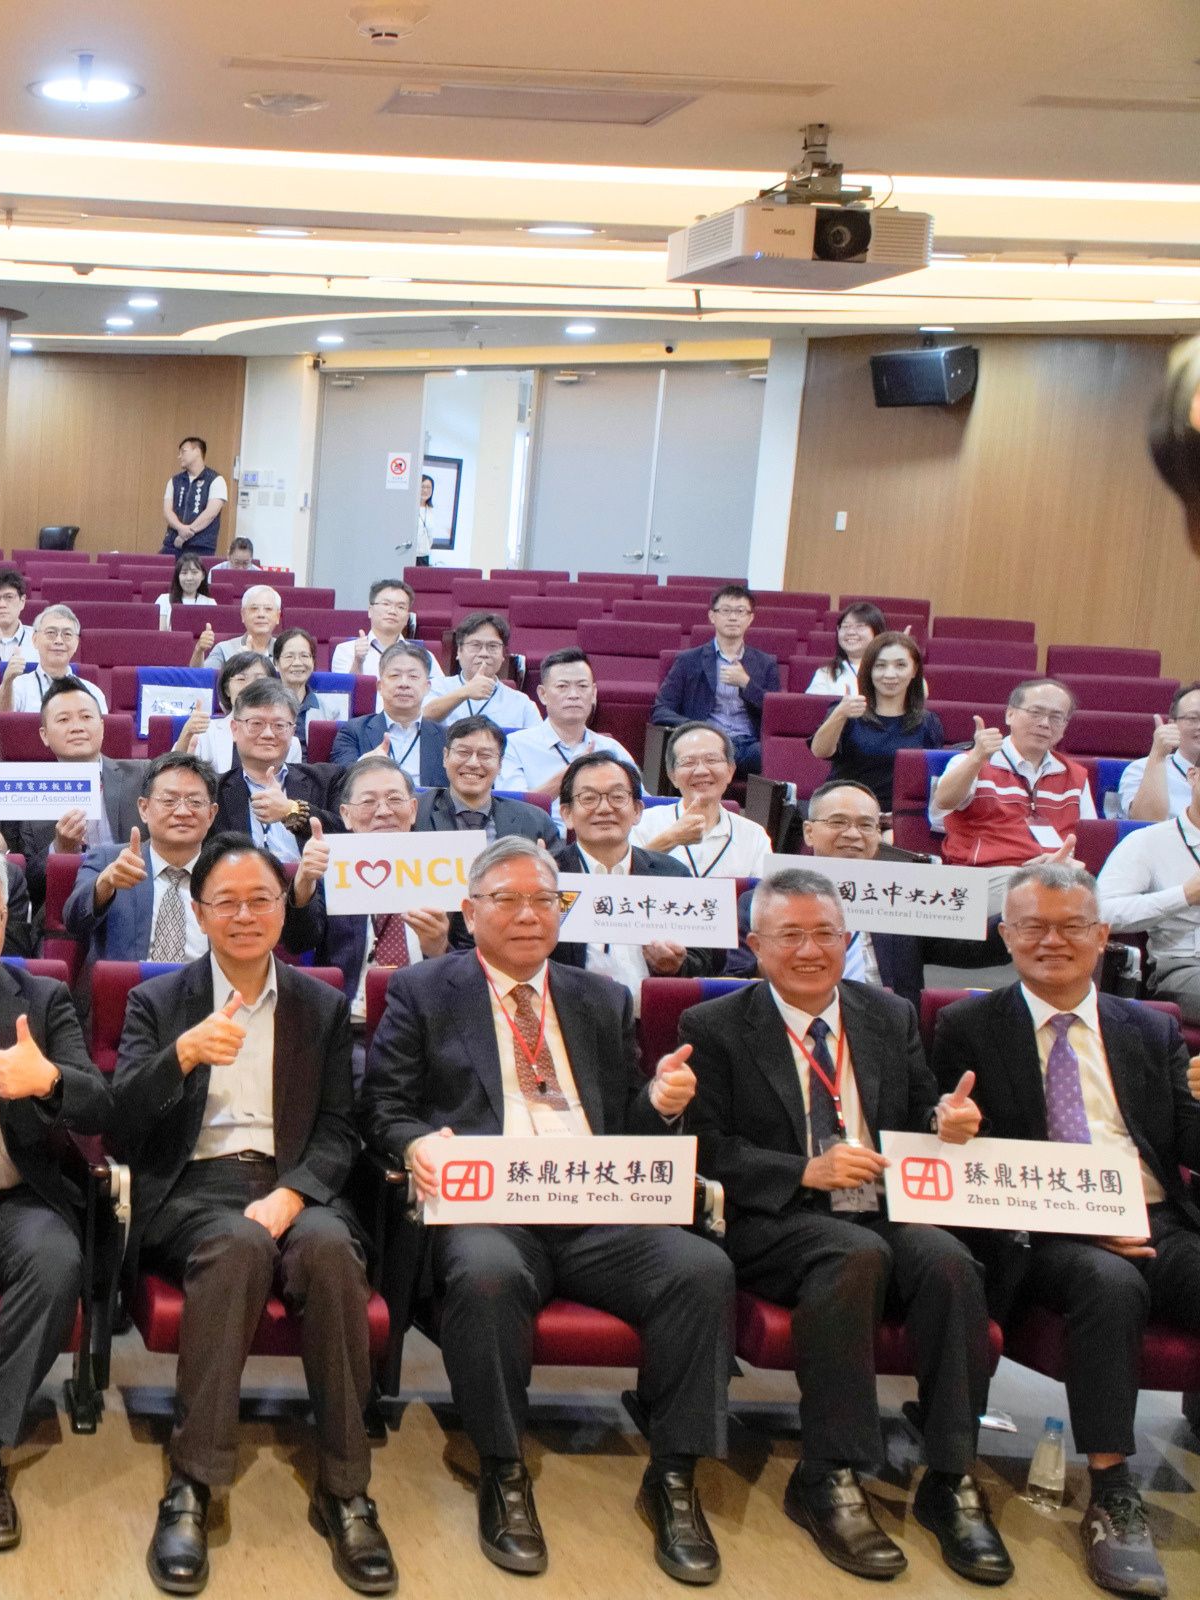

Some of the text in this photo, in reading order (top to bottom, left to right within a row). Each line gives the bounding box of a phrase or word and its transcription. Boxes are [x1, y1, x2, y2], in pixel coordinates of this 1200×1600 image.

[10, 795, 38, 803] Circuit
[41, 795, 91, 803] Association
[333, 861, 351, 889] I
[837, 881, 969, 911] 國立中央大學
[593, 895, 719, 921] 國立中央大學
[847, 907, 965, 922] tional Central University
[594, 920, 717, 932] National Central University
[506, 1160, 673, 1185] 臻鼎科技集團
[964, 1162, 1122, 1196] 臻鼎科技集團
[506, 1192, 672, 1204] Zhen Ding Tech. Group
[967, 1194, 1126, 1215] Zhen Ding Tech. Group
